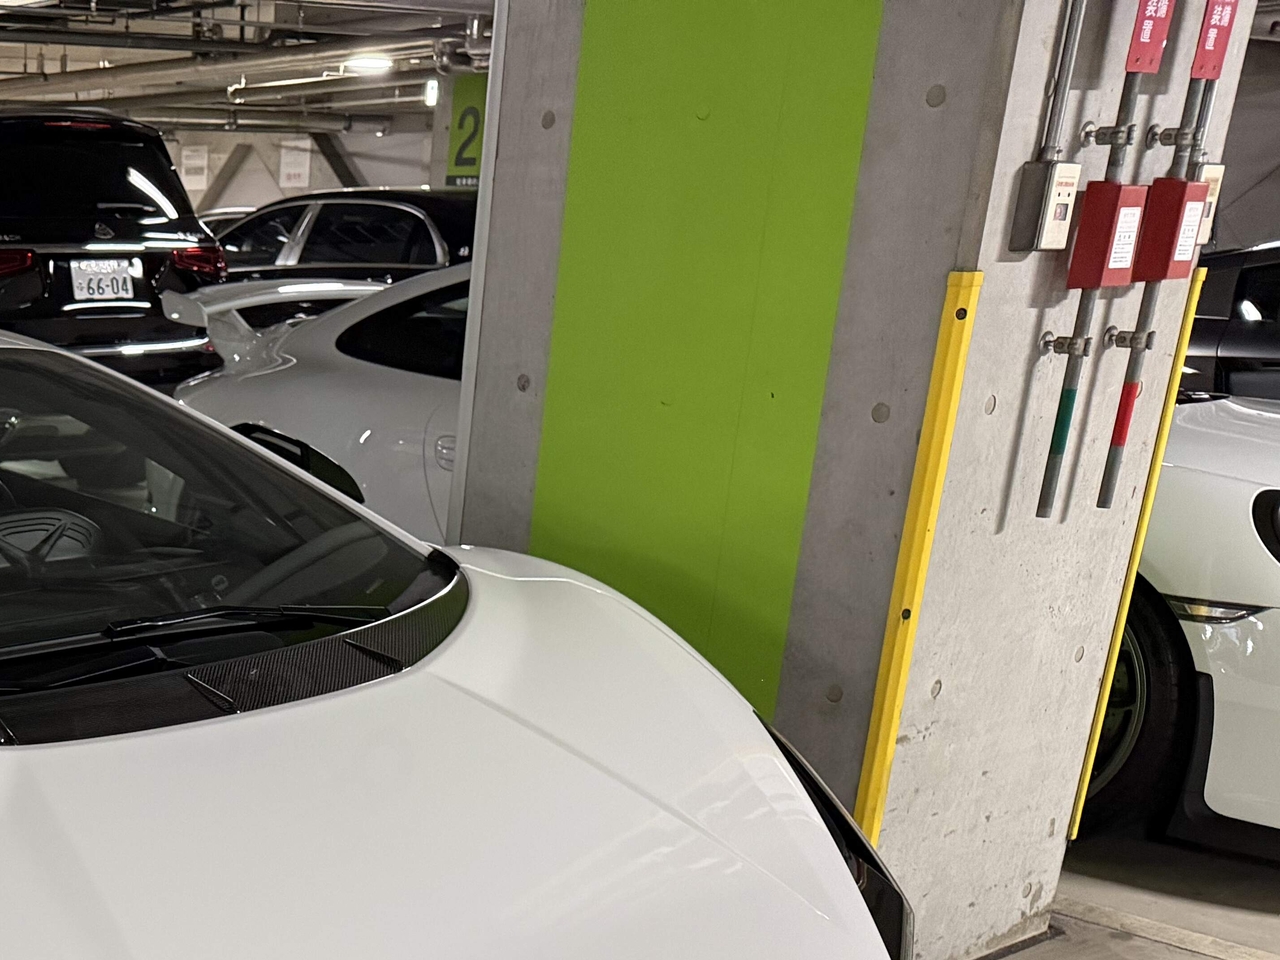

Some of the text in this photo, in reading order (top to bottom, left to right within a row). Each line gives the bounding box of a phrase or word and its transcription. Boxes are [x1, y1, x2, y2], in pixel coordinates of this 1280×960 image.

[1205, 0, 1222, 51] 装置
[455, 106, 480, 167] 2
[87, 275, 130, 296] 66-04
